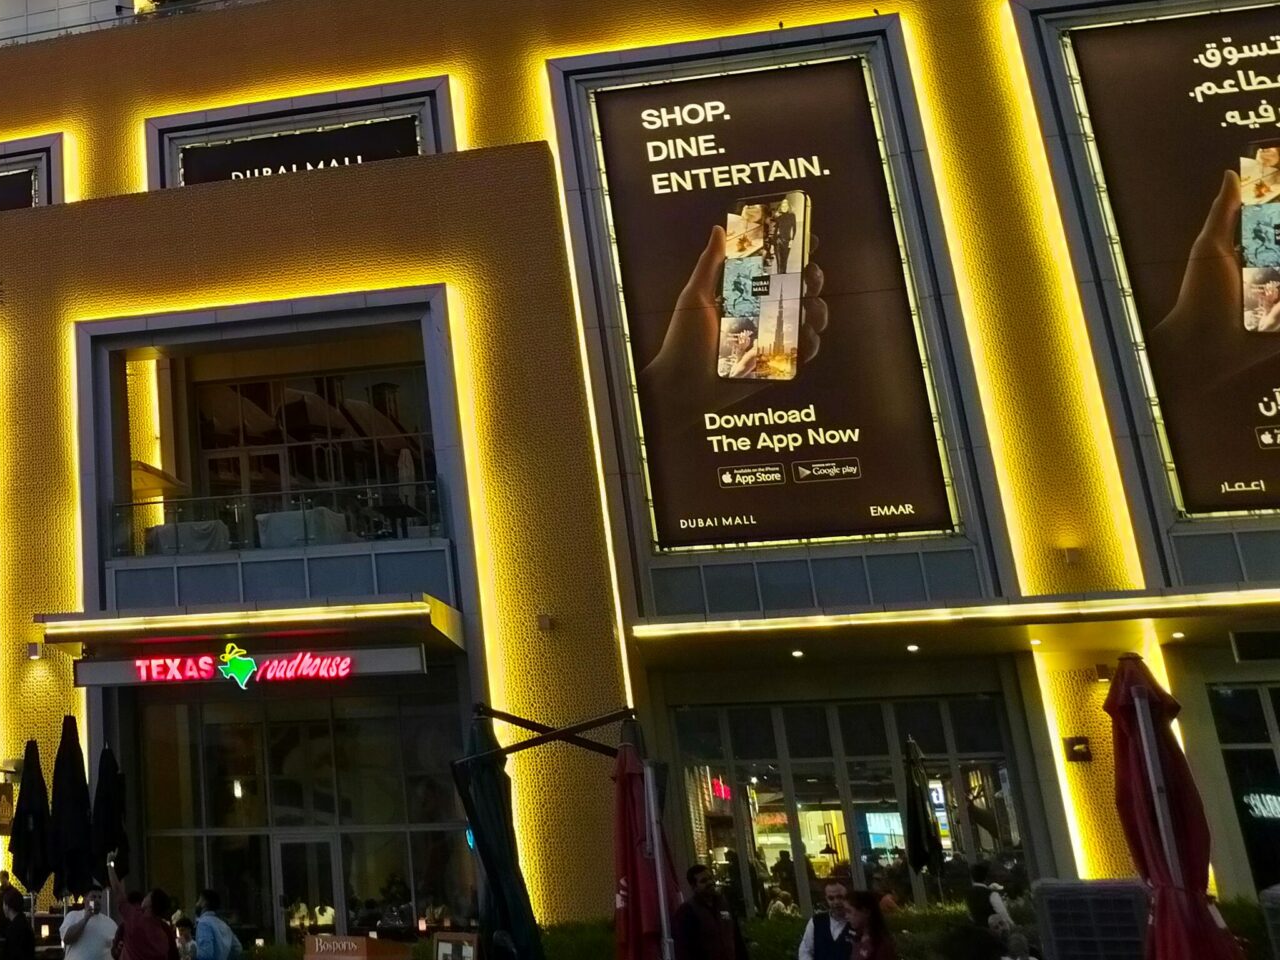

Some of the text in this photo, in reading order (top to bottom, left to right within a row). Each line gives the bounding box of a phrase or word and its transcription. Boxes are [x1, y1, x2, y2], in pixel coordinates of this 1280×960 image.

[640, 100, 731, 131] SHOP.
[646, 134, 726, 162] DINE.
[651, 155, 831, 195] ENTERTAIN.
[704, 404, 816, 430] Download
[707, 426, 860, 453] The App Now
[735, 472, 782, 485] App Store
[812, 466, 841, 477] Google
[841, 465, 858, 475] play
[679, 514, 757, 529] DUBAI MALL
[870, 503, 915, 517] EMAAR
[135, 655, 215, 682] TEXAS
